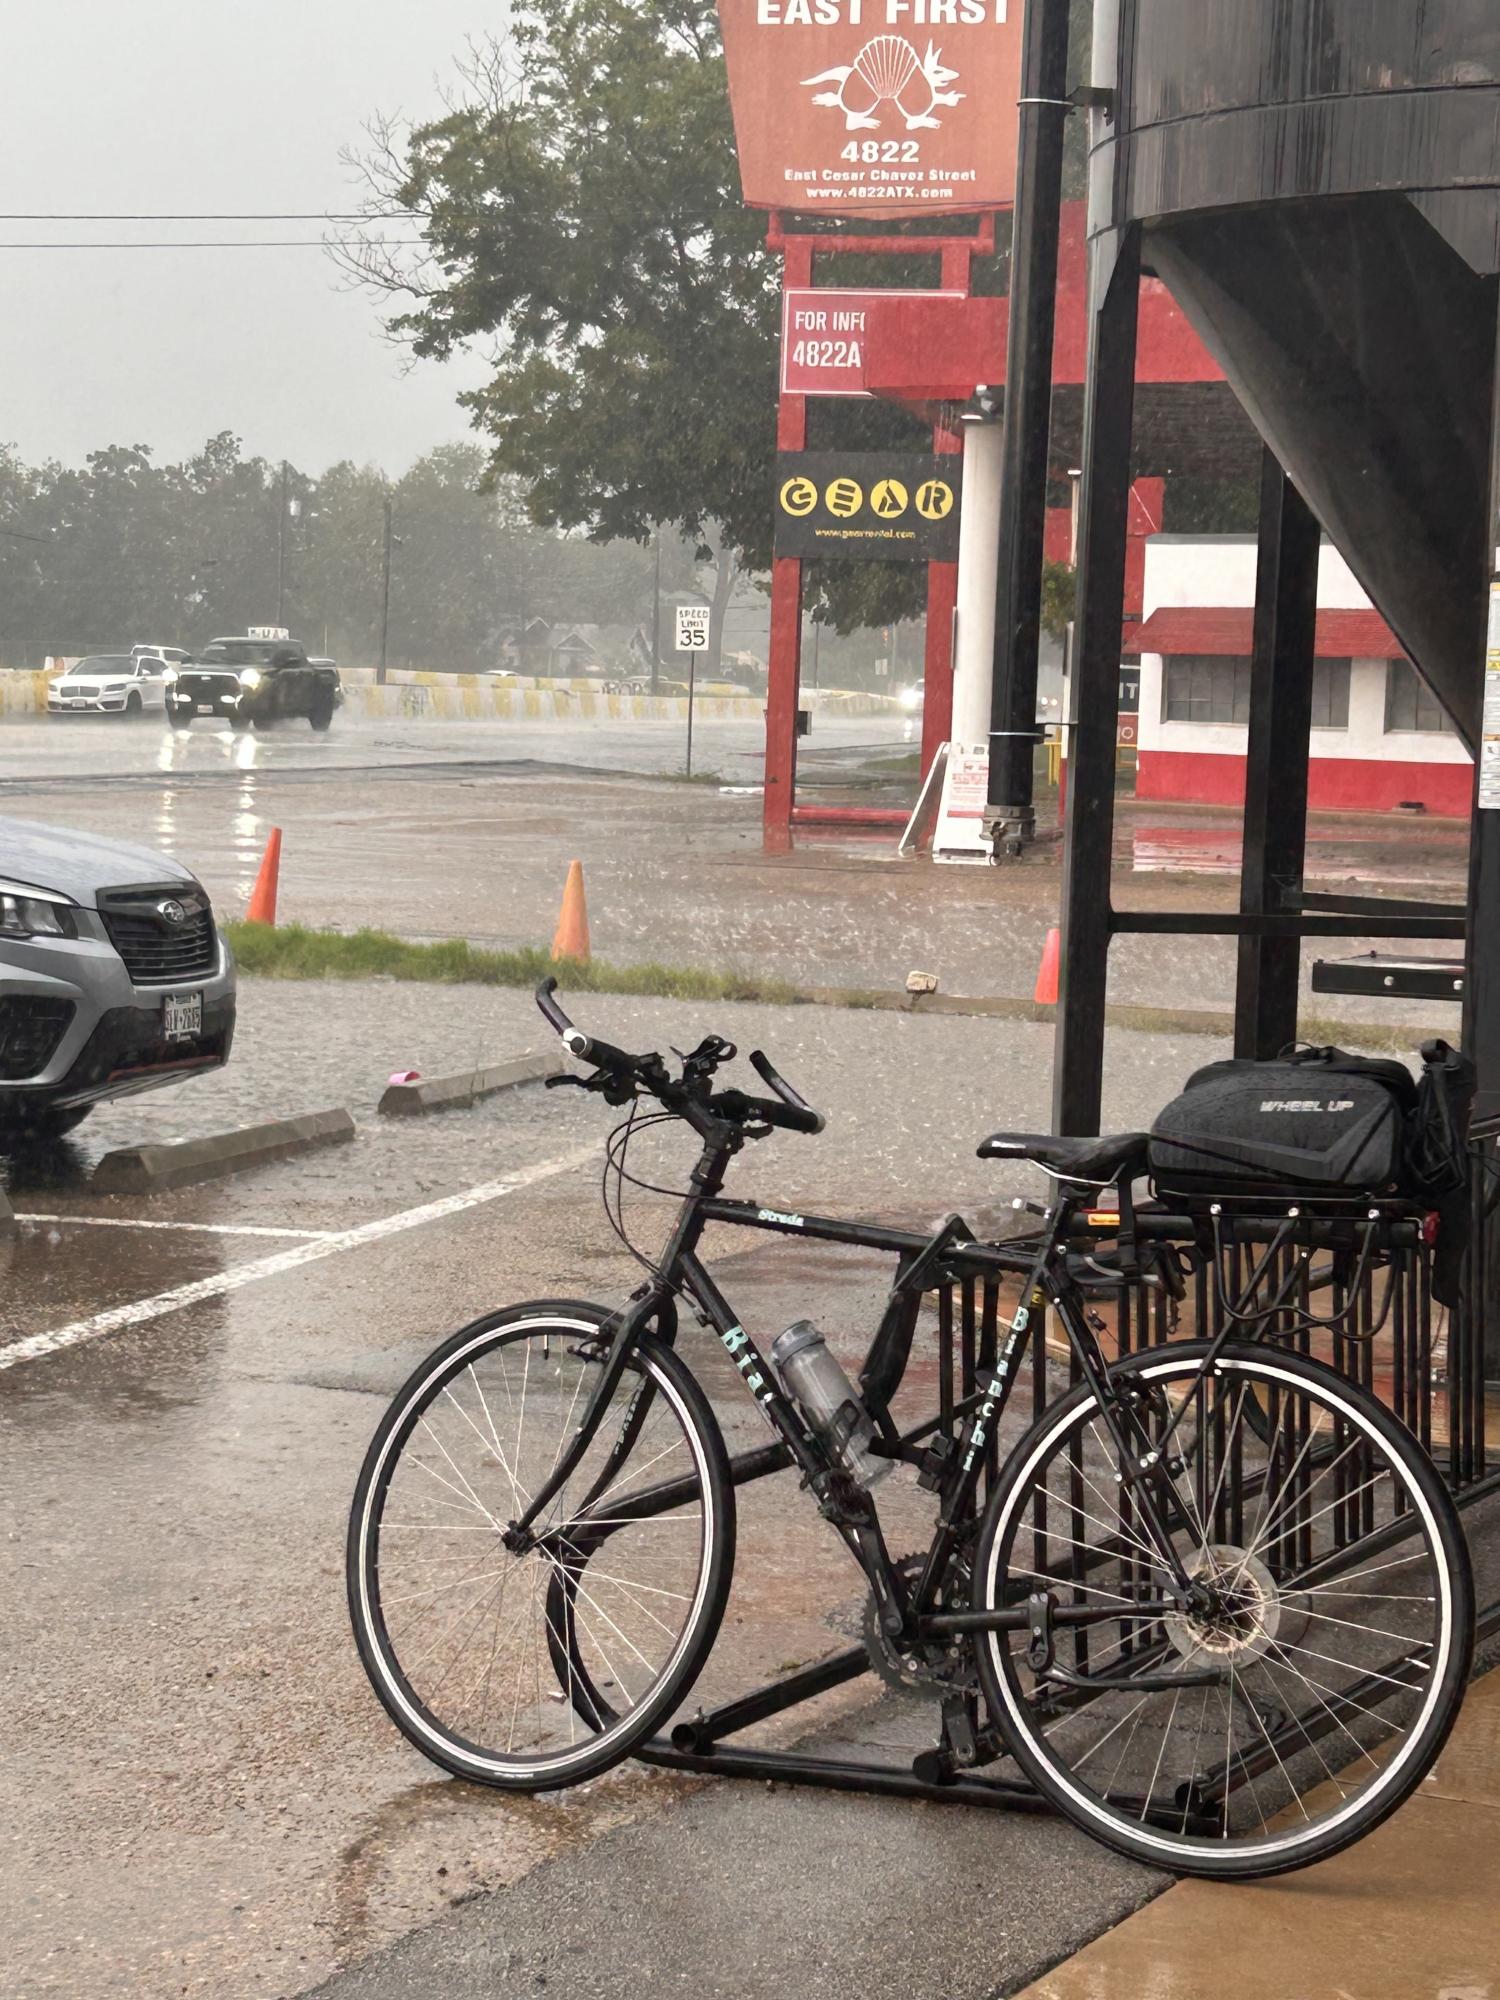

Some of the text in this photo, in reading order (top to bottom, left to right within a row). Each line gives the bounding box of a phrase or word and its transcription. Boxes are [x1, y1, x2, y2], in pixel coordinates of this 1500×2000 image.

[757, 0, 1009, 25] EAST FIRST
[840, 140, 919, 164] 4822
[784, 168, 817, 181] East
[870, 168, 924, 181] Chavez
[928, 168, 976, 181] Street
[806, 186, 953, 198] www.4822ATX.com
[795, 311, 827, 331] FOR
[792, 341, 865, 368] 4822A
[679, 609, 709, 619] SPEED
[681, 620, 704, 628] LIMIT
[680, 629, 706, 647] 35
[1260, 1101, 1354, 1112] WHEEL UP
